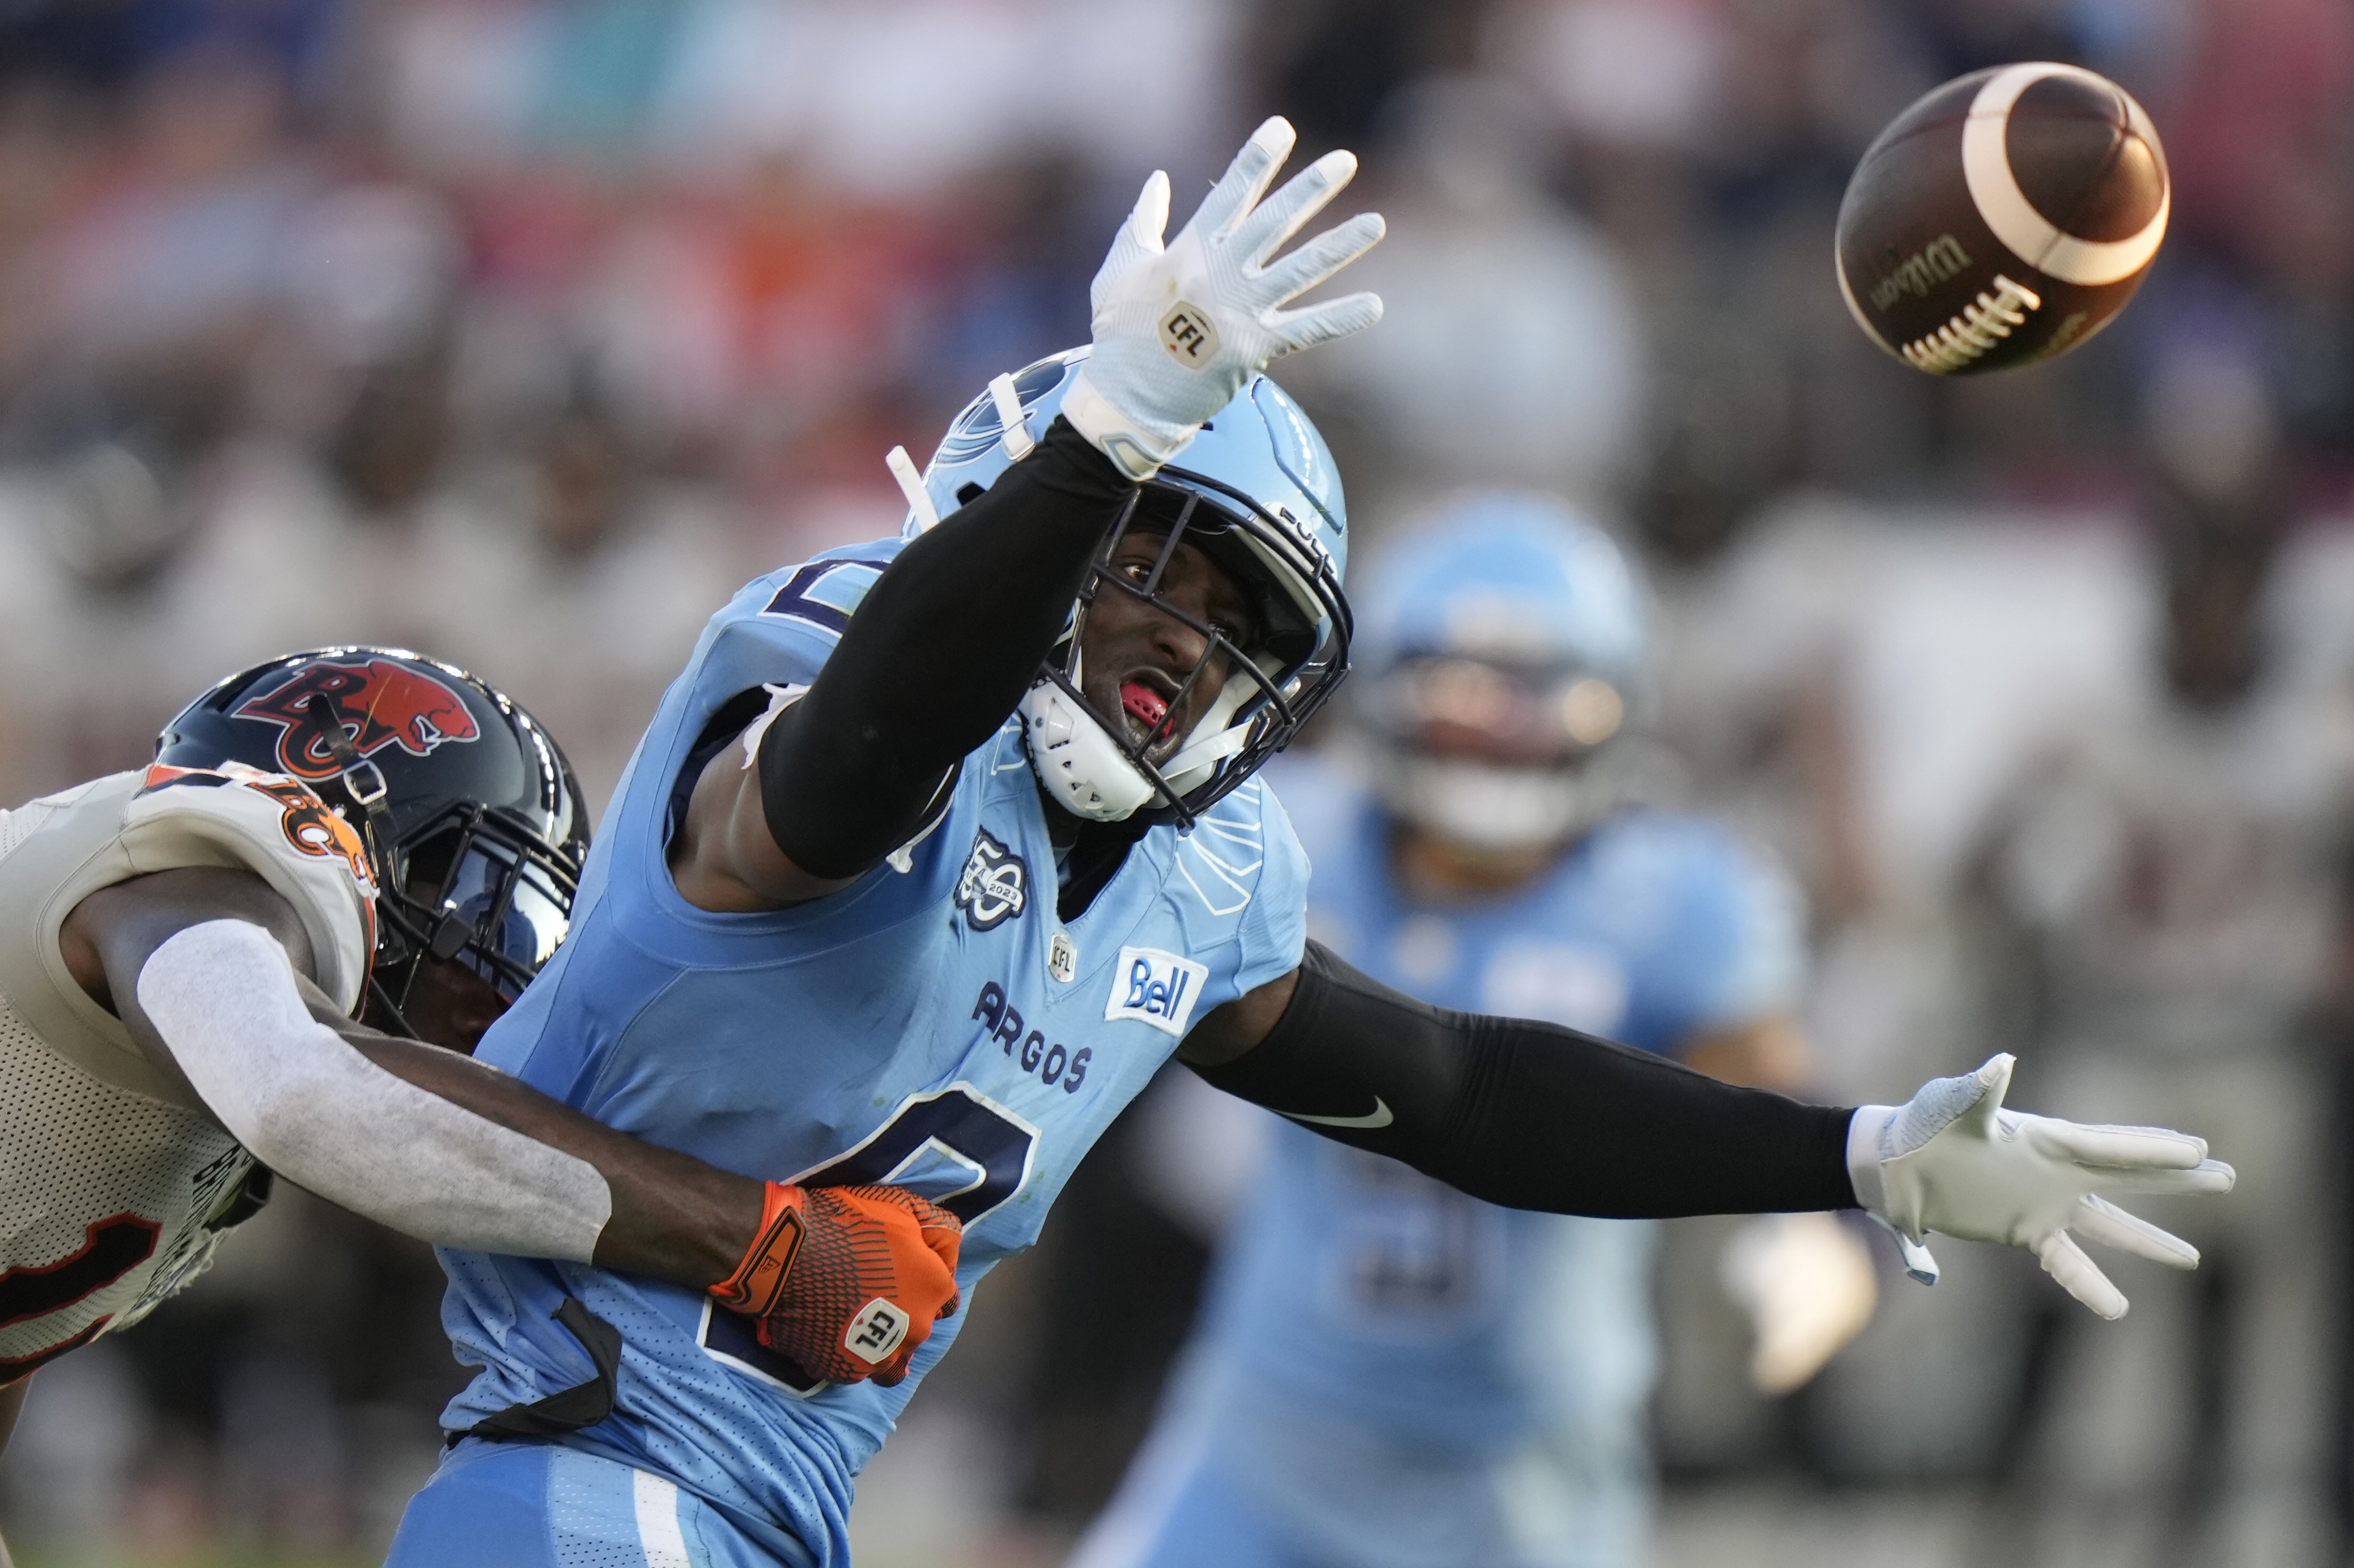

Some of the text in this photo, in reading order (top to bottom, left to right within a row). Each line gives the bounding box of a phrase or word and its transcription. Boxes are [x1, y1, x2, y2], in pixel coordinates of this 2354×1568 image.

[1167, 313, 1205, 358] CFL
[1280, 507, 1334, 574] PULL
[231, 661, 402, 783] BC
[959, 835, 1022, 922] 50
[988, 883, 1018, 900] 2023
[1053, 944, 1071, 973] CFL
[1123, 958, 1190, 1021] Bell
[971, 981, 1092, 1094] ARGOS
[855, 1310, 895, 1348] CFL
